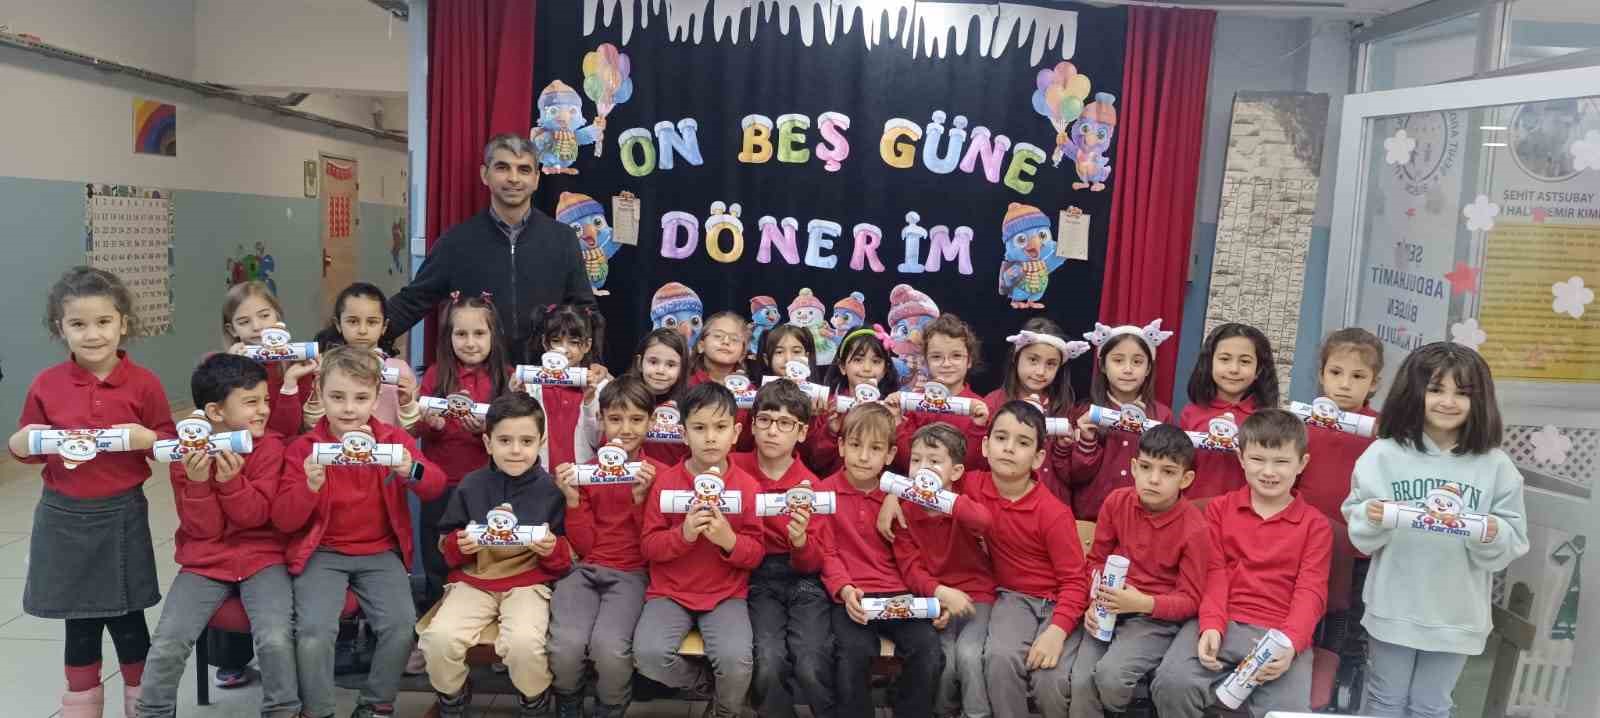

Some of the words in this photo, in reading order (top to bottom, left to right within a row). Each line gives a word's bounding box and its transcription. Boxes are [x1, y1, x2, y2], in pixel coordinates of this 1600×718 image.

[617, 118, 704, 177] ON
[737, 111, 851, 172] BEŞ
[880, 110, 1047, 195] GÜNE
[659, 200, 974, 275] DÖNERİM
[1391, 478, 1483, 511] BROOYN
